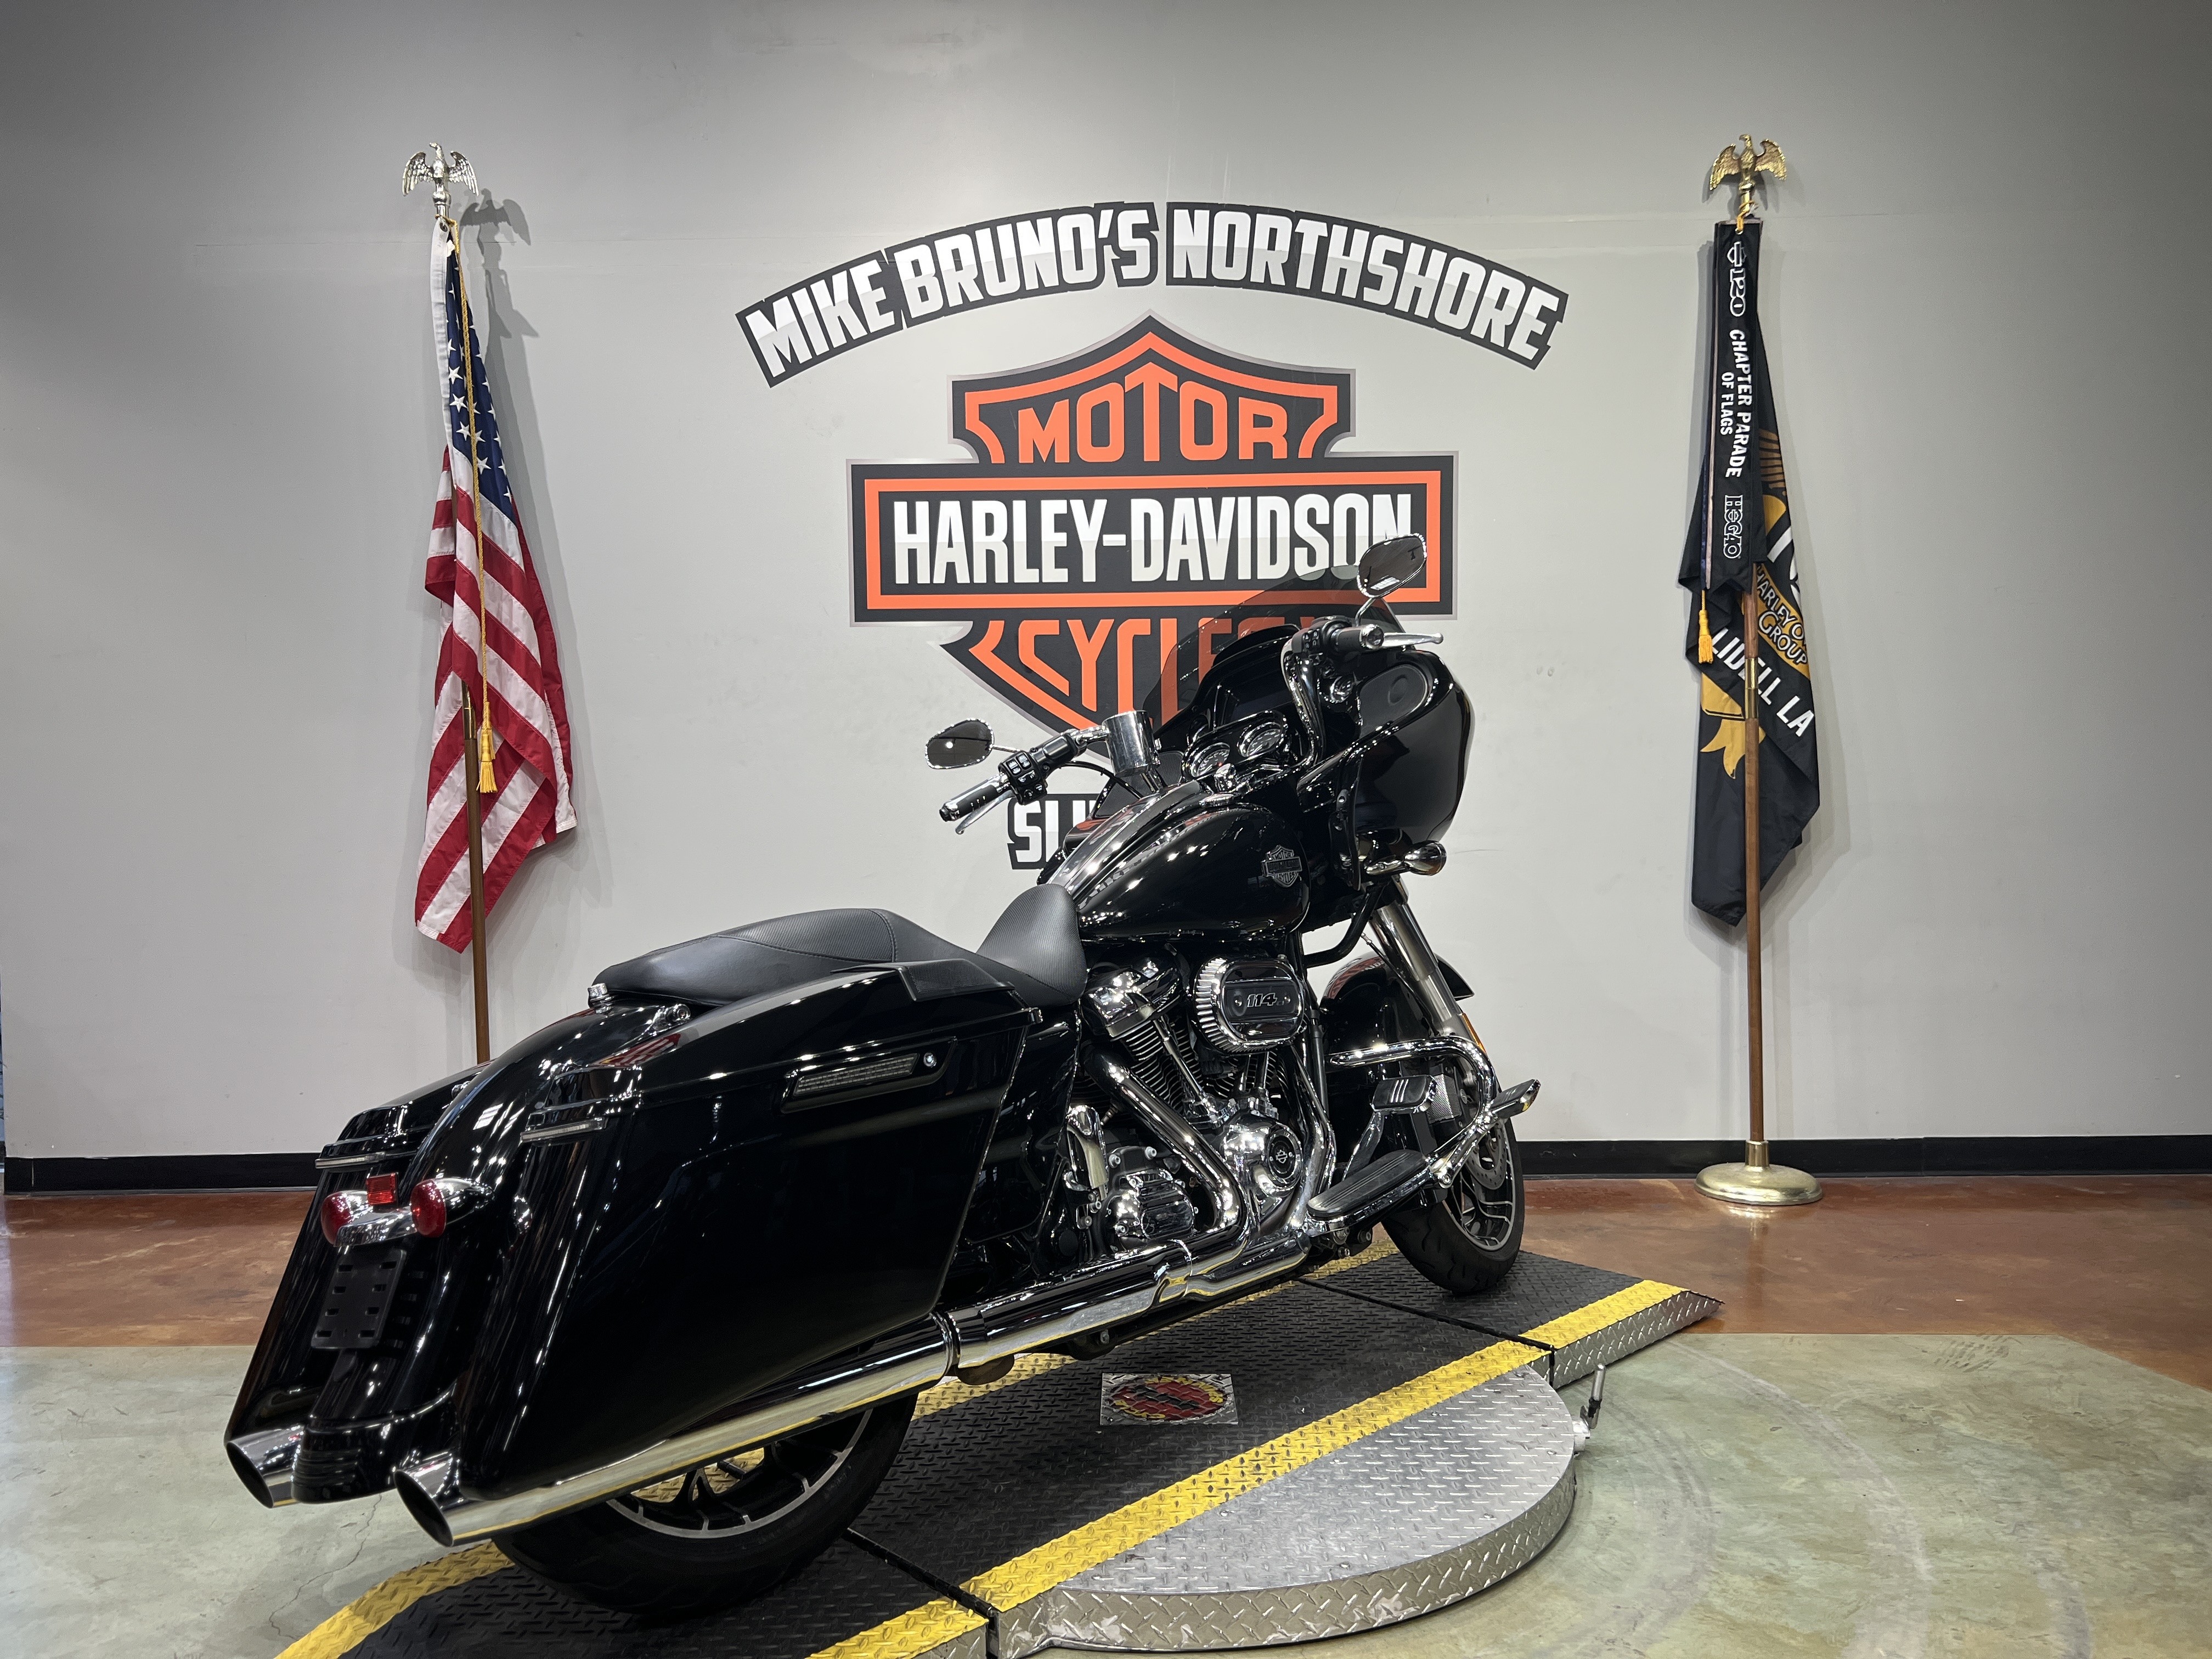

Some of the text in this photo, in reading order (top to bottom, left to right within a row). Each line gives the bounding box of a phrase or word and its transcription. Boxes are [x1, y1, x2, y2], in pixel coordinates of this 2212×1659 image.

[744, 208, 1560, 379] MIKE BRUNO'S NORTHSHORE
[1018, 362, 1288, 463] MOTOR
[1719, 372, 1734, 436] OF FLAGS
[1725, 329, 1752, 477] CHAPTER PARADE
[894, 493, 1411, 585] HARLEY-DAVIDSON
[1018, 617, 1285, 724] CYCLE
[1758, 611, 1808, 664] GROUP
[1776, 695, 1815, 737] LA
[1246, 992, 1278, 1008] 114
